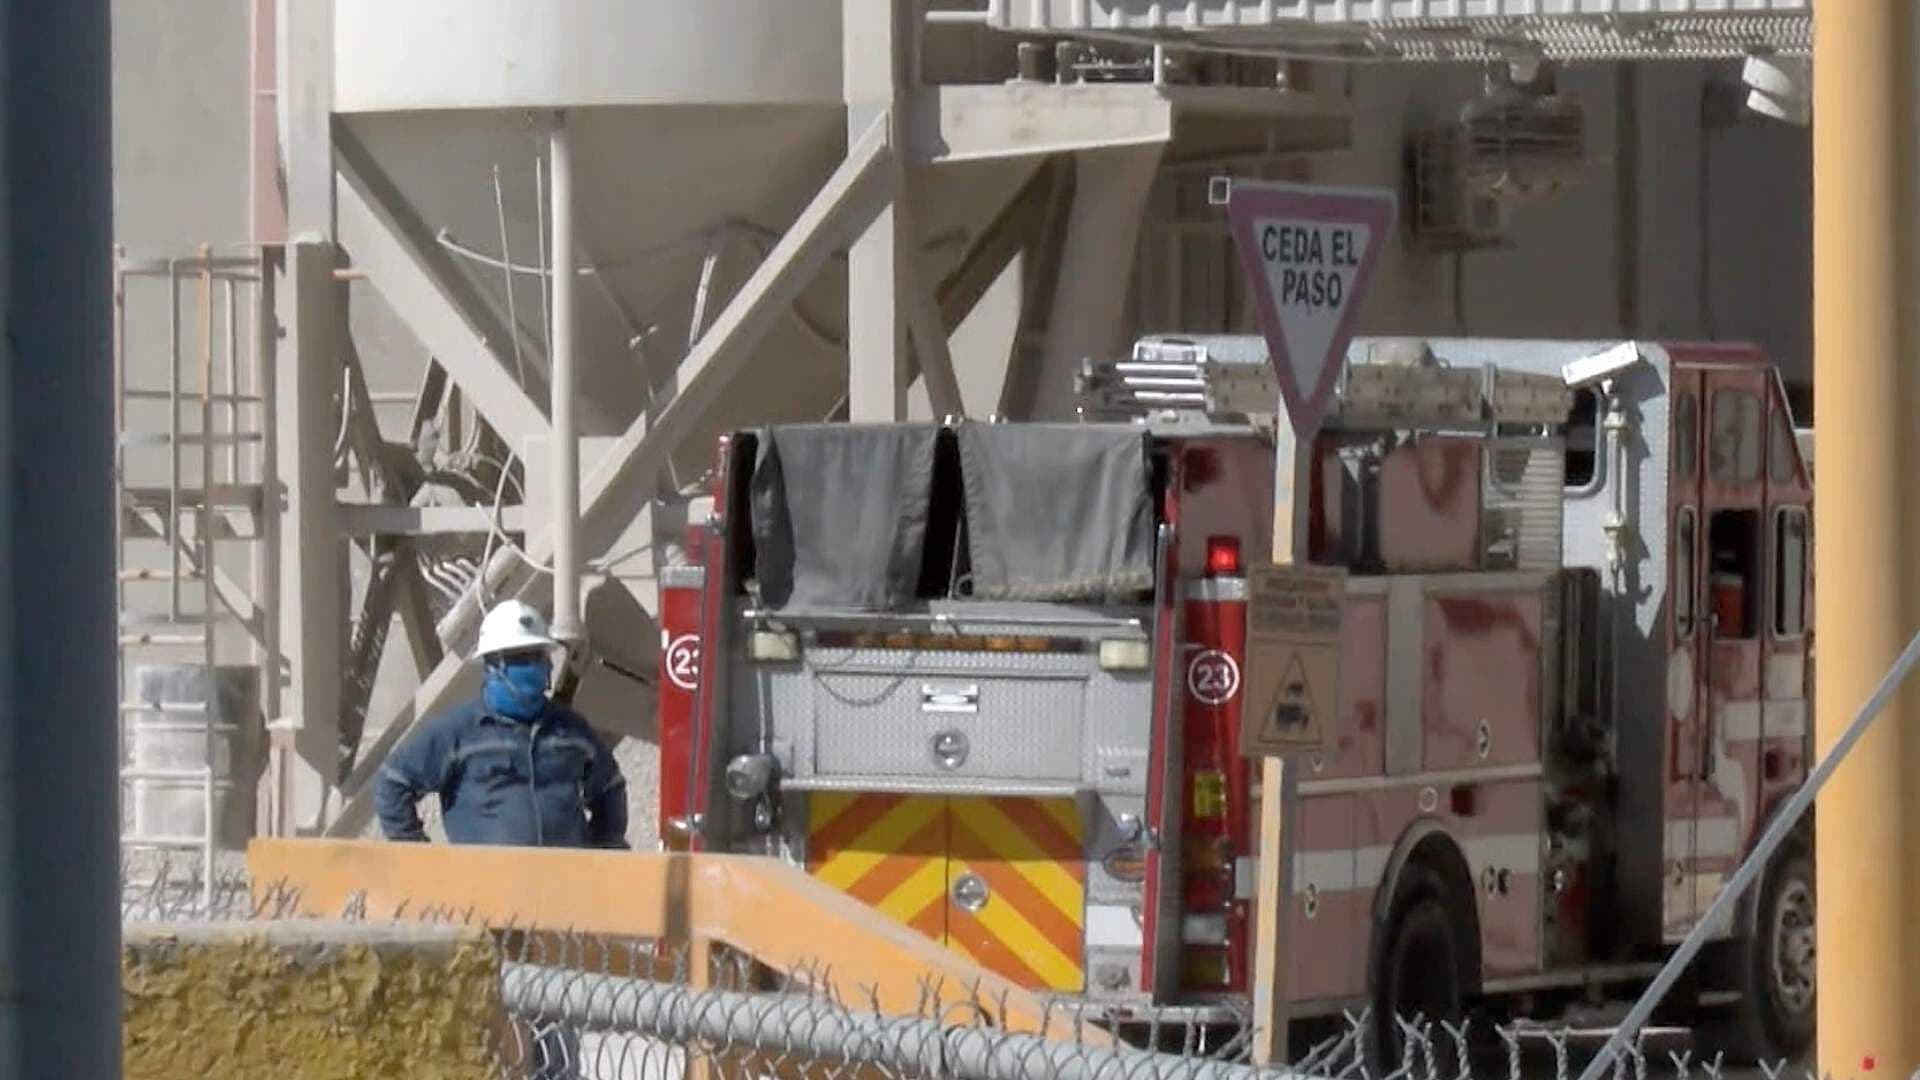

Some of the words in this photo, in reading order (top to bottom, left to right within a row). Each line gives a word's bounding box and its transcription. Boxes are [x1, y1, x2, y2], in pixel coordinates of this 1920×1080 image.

[1262, 225, 1324, 264] CEDA
[1331, 229, 1358, 266] EL
[1281, 268, 1343, 308] PASO
[1197, 663, 1230, 690] 23
